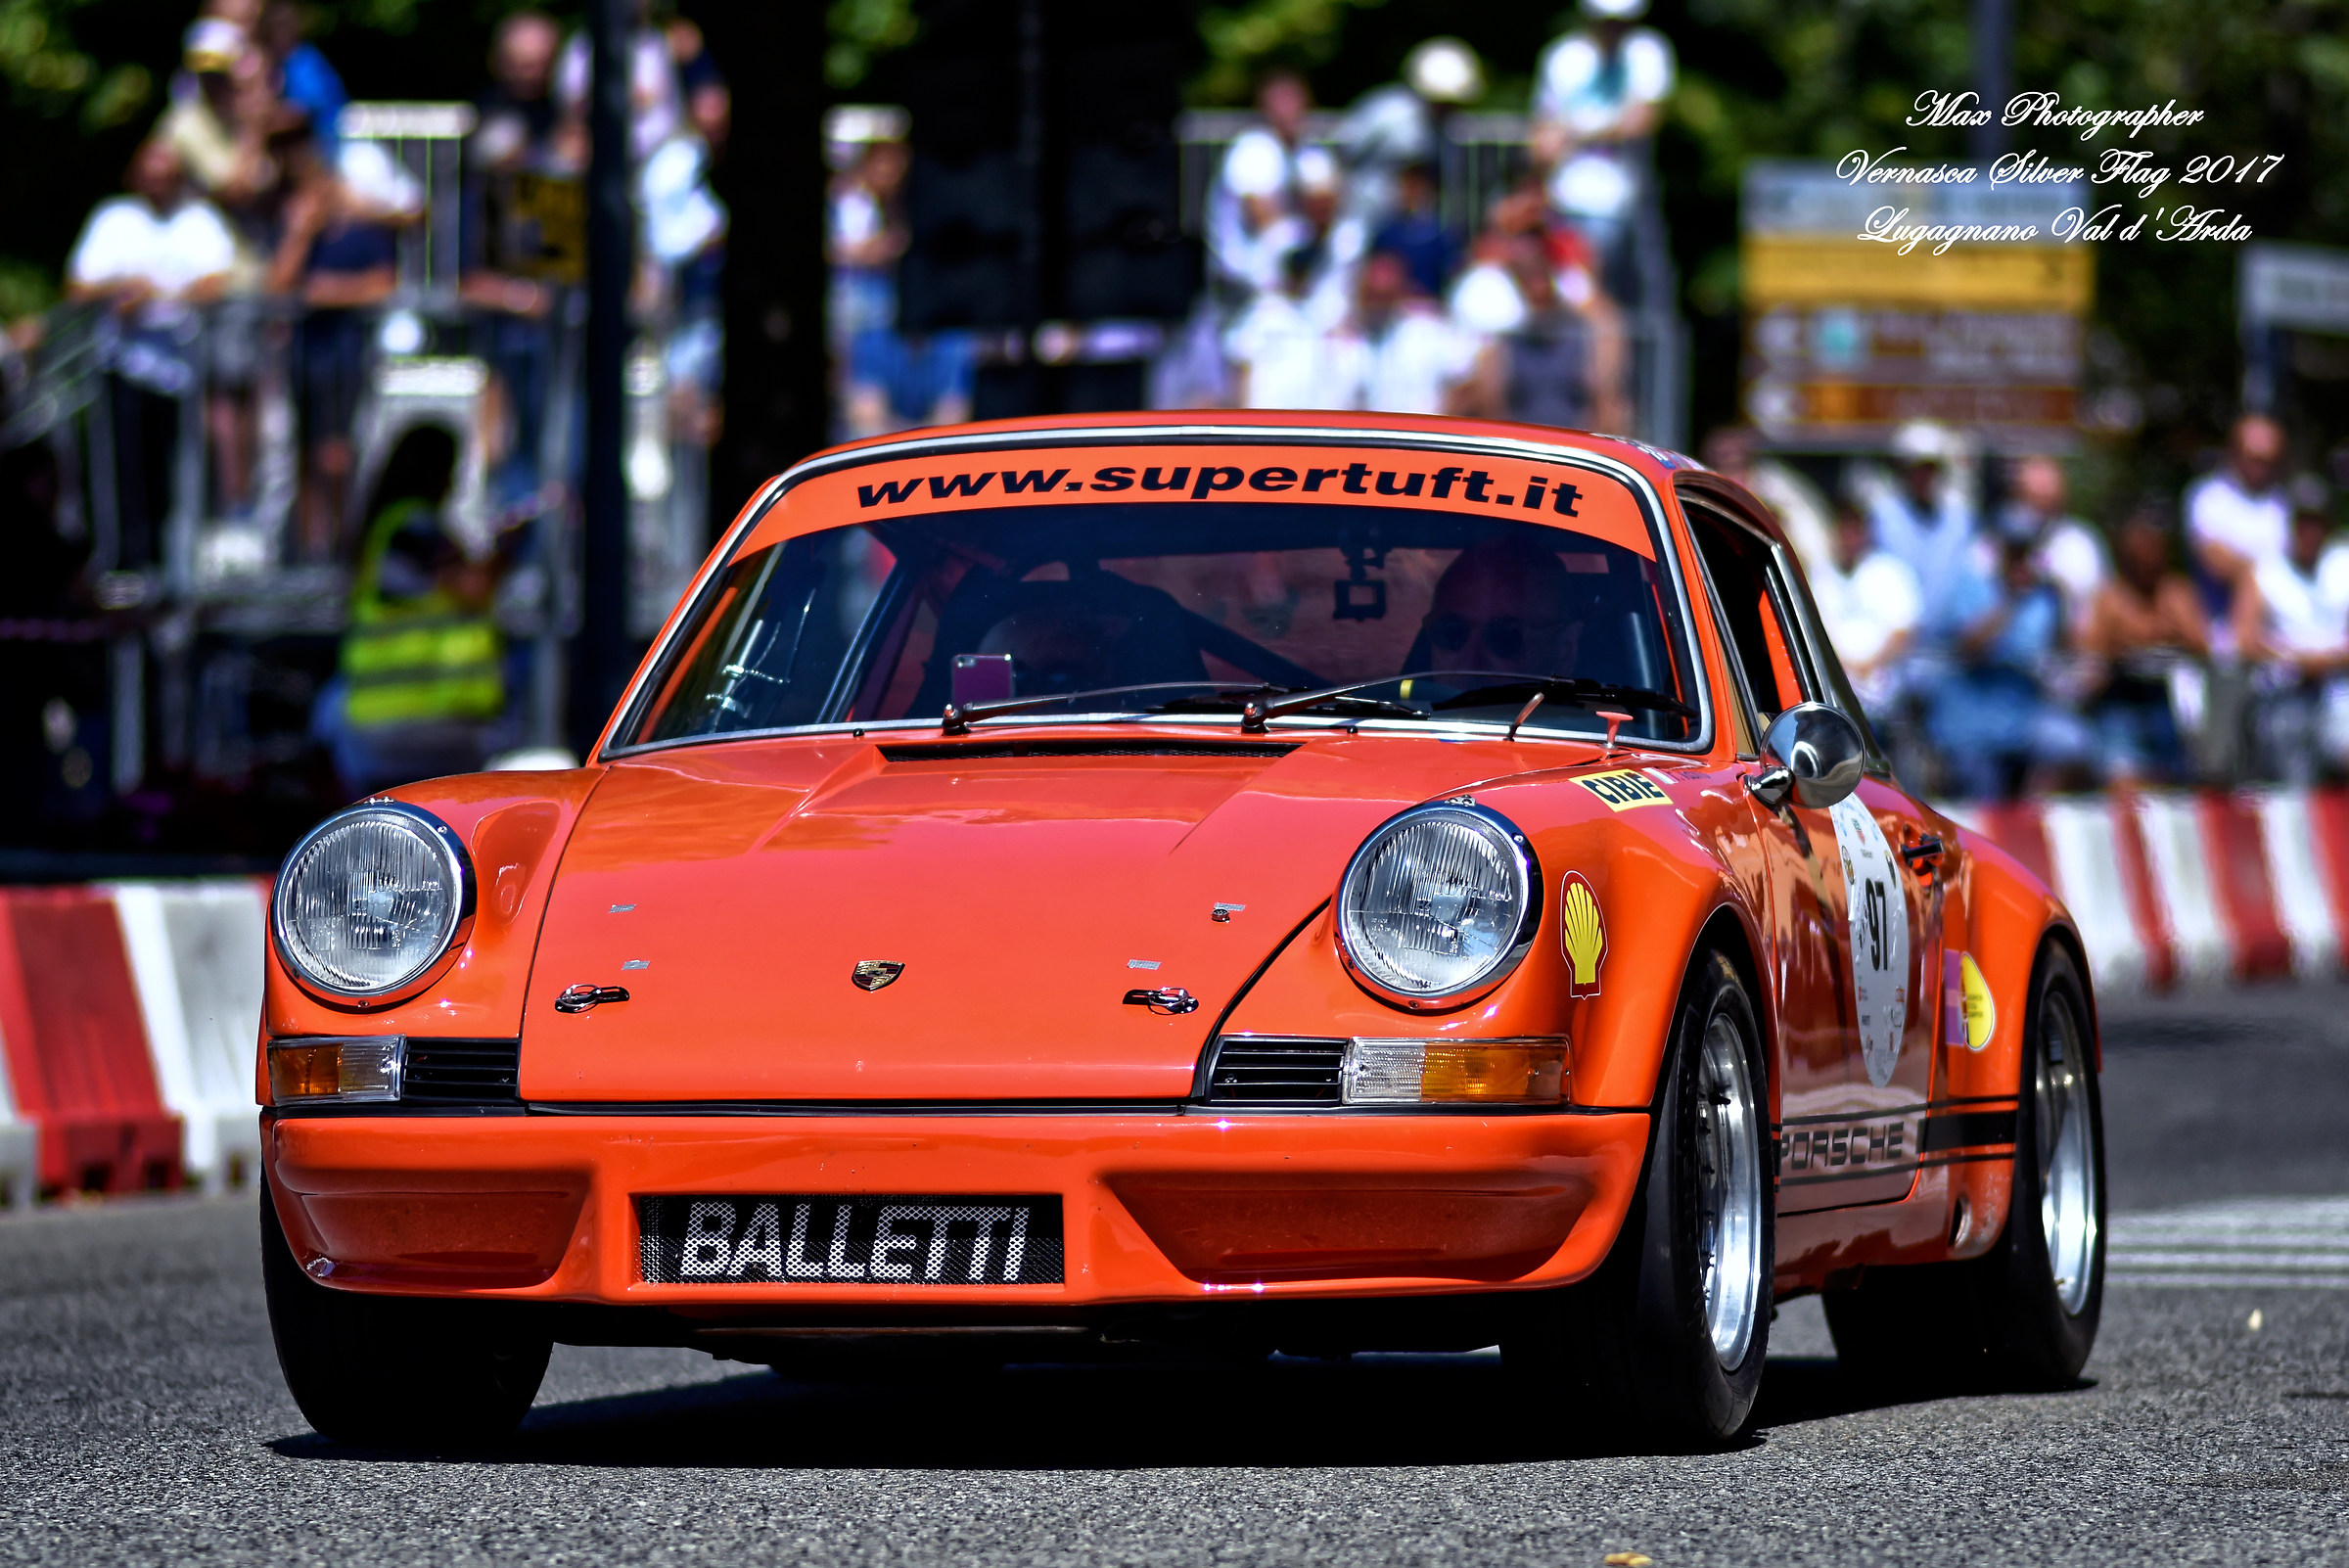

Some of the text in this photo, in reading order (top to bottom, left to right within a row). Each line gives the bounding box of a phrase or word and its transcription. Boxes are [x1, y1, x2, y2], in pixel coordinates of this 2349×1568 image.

[856, 463, 1584, 519] www.supertuft.it
[1582, 771, 1666, 804] CIBIE
[1865, 877, 1888, 972] 97
[1780, 1122, 1904, 1171] PORSCHE
[680, 1200, 1030, 1281] BALLETTI
